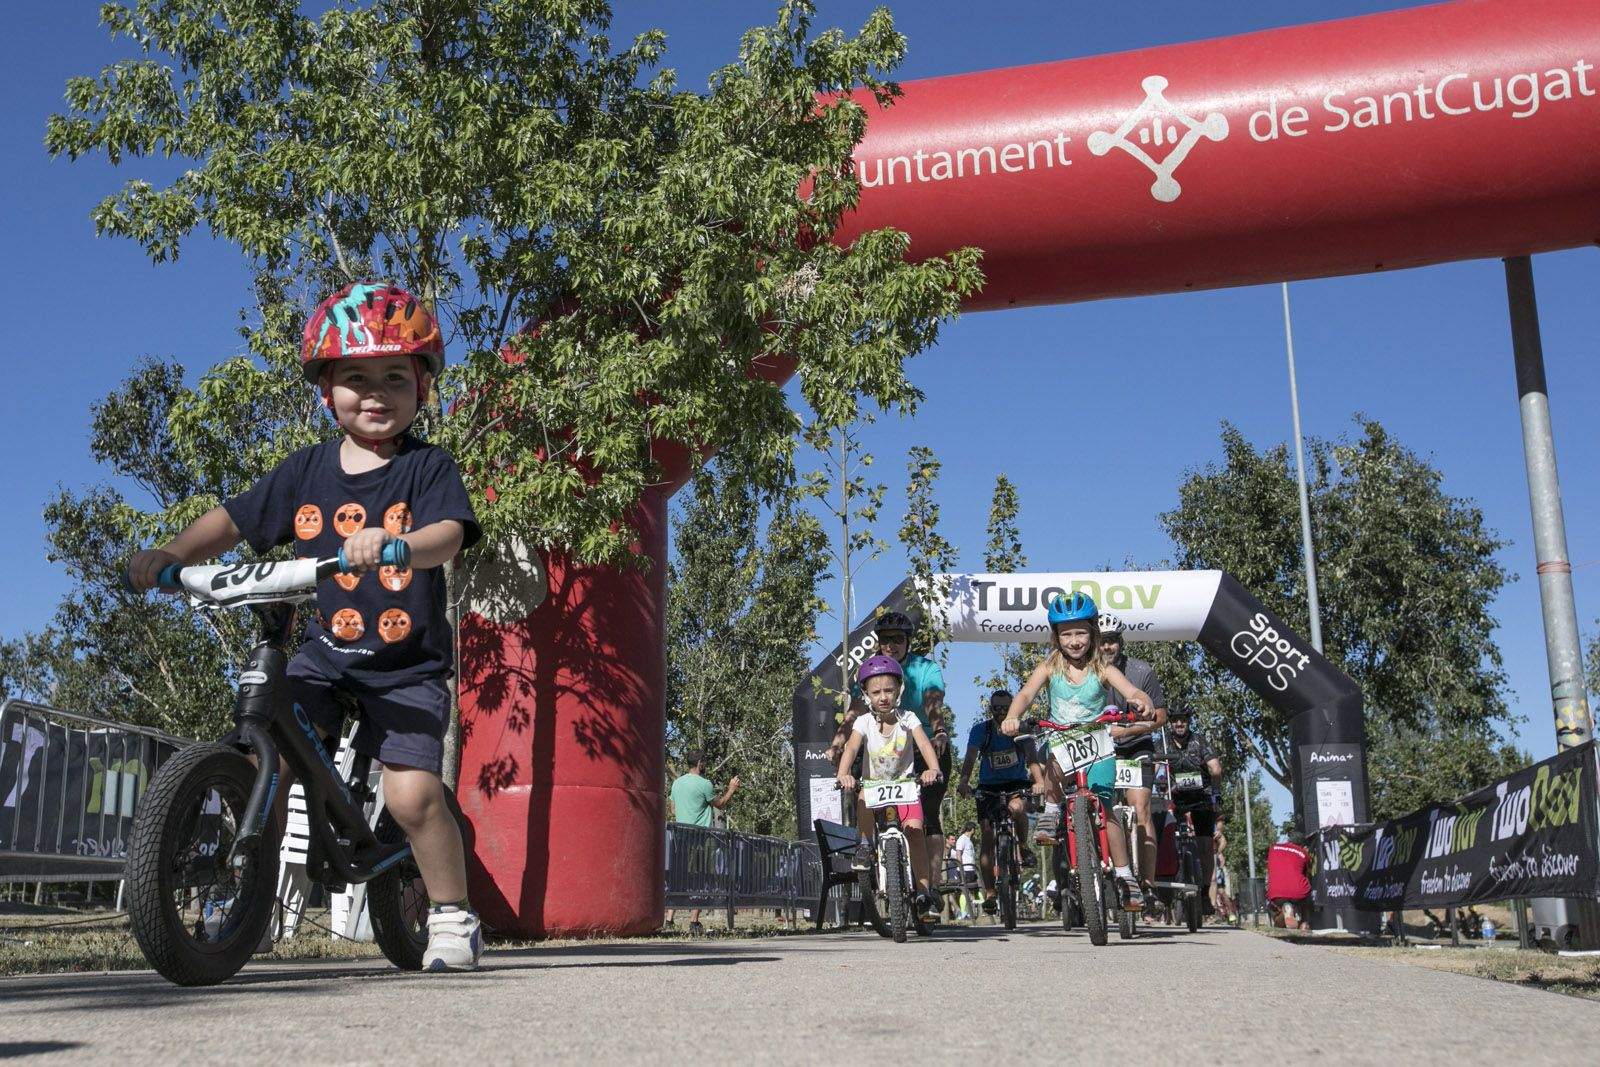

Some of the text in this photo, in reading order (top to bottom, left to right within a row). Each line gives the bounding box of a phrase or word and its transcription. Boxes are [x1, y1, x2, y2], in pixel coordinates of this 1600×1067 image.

[859, 59, 1596, 188] untament de SantCugat
[971, 579, 1162, 611] TwoNav
[979, 619, 1155, 633] freedom over
[836, 629, 879, 671] Spo
[1249, 612, 1311, 671] Sport
[1231, 630, 1297, 691] GPS
[1067, 735, 1095, 763] 267
[1310, 751, 1354, 763] Anima+
[1116, 768, 1132, 784] 49
[877, 785, 904, 802] 272
